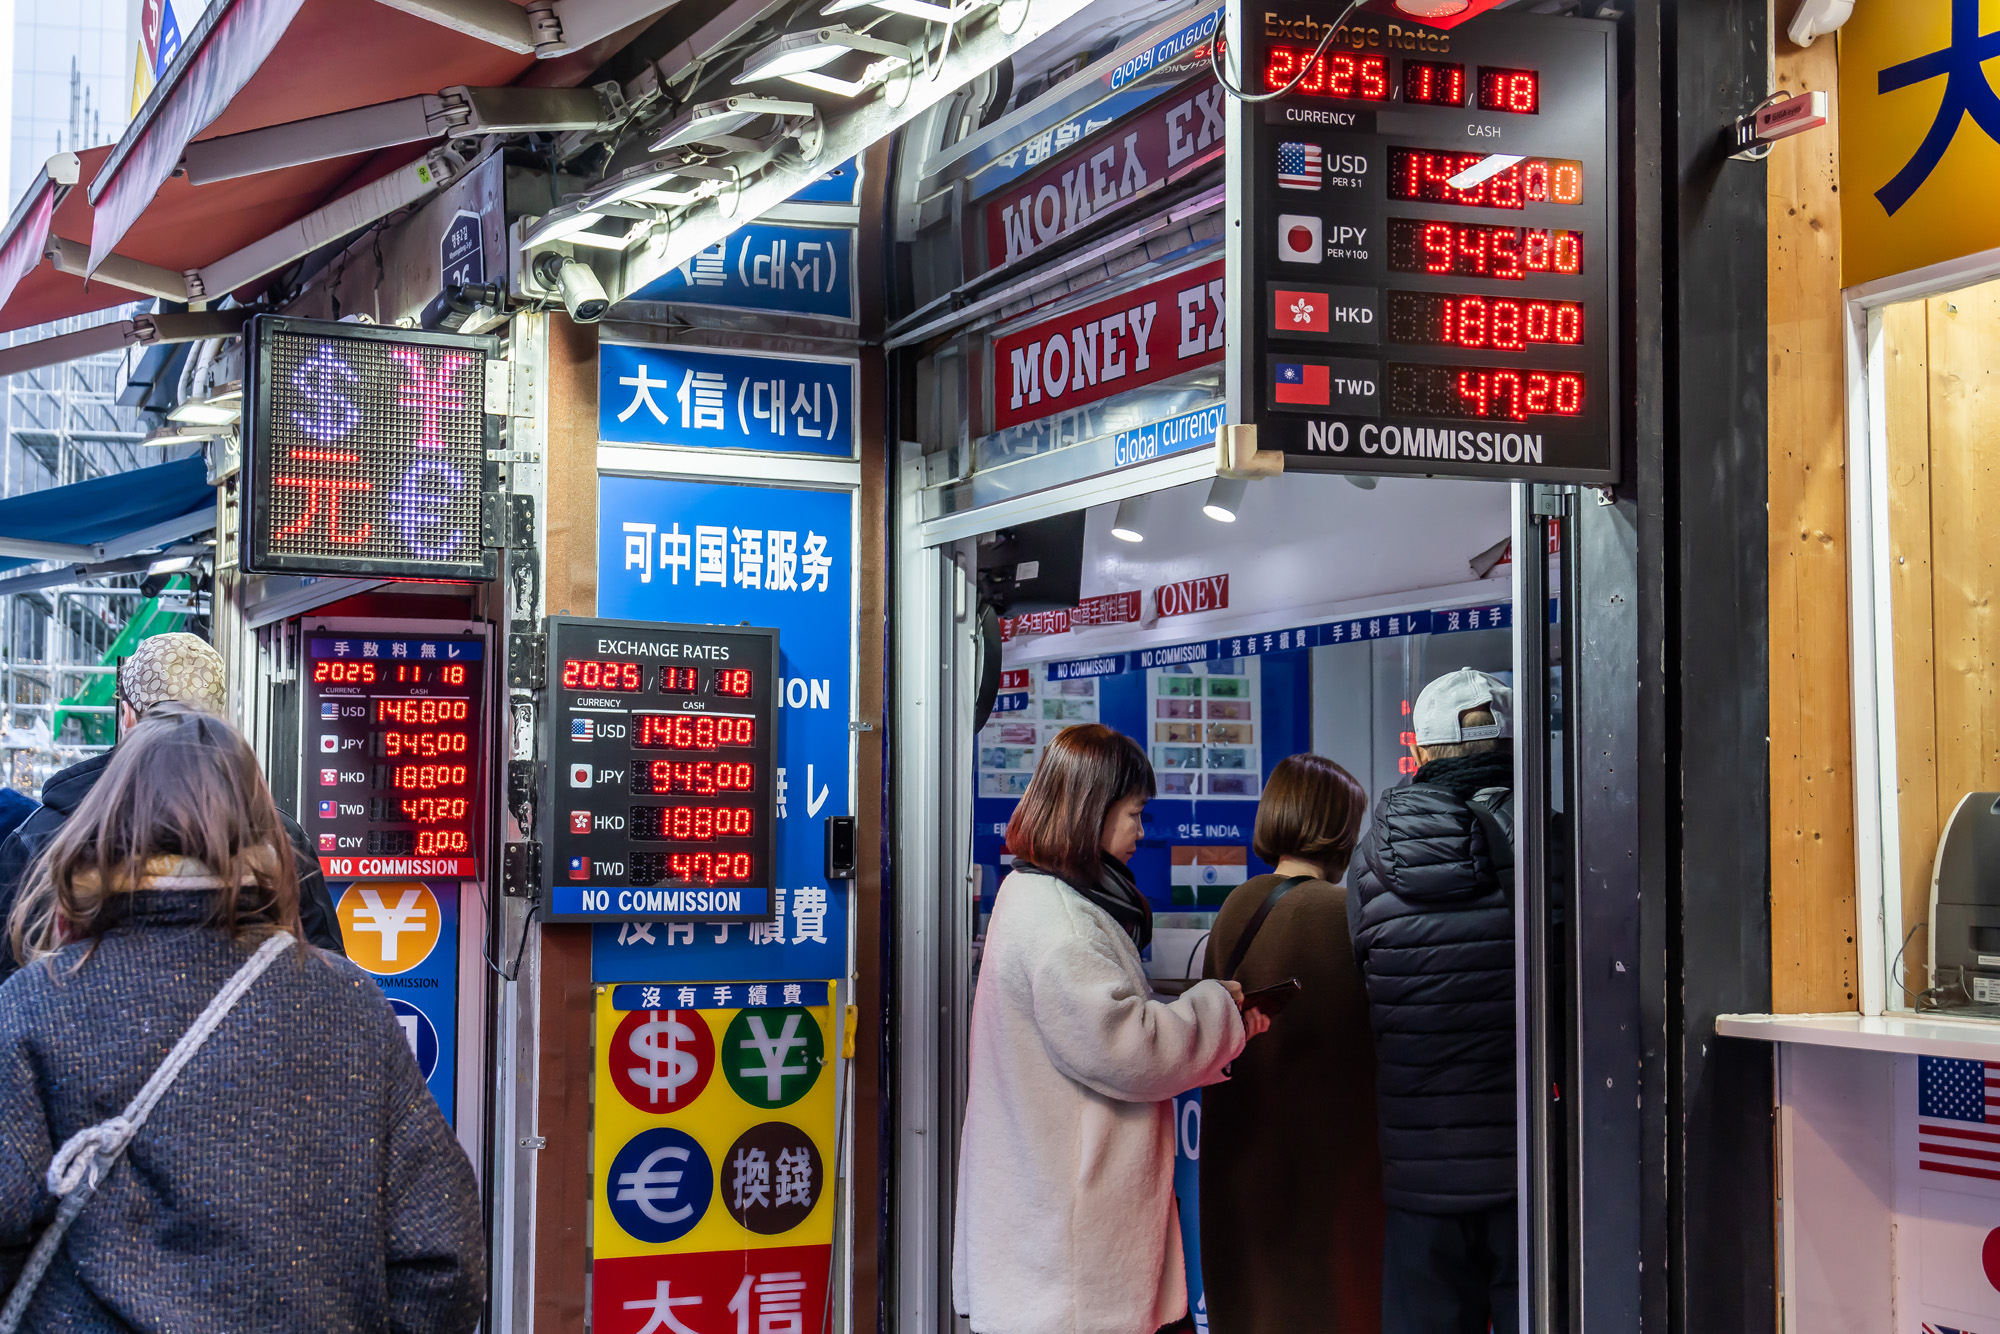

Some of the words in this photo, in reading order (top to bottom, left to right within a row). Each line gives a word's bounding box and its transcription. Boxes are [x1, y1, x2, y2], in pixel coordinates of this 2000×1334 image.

[1388, 24, 1450, 53] Rates
[1269, 51, 1386, 97] 2025
[1418, 68, 1461, 103] 11
[1494, 73, 1533, 111] 18
[1286, 108, 1355, 126] CURRENCY
[1467, 124, 1501, 138] CASH
[1327, 155, 1367, 174] USD
[1332, 177, 1348, 187] PER
[1328, 226, 1367, 245] JPY
[1327, 248, 1344, 258] PER
[1335, 307, 1373, 324] HKD
[1010, 301, 1157, 411] MONEY
[1335, 378, 1376, 396] TWD
[1115, 427, 1158, 465] Global
[1162, 406, 1224, 446] currency
[1307, 420, 1349, 451] NO
[1359, 424, 1543, 464] COMMISSION
[622, 522, 832, 592] 可中国语服务
[1158, 576, 1227, 615] ONEY
[1448, 606, 1512, 631] 沒有手
[598, 640, 679, 657] EXCHANGE
[683, 644, 729, 660] RATES
[1141, 652, 1153, 667] NO
[1155, 643, 1207, 665] COMMISSION
[314, 663, 376, 683] 2025
[399, 666, 421, 682] 11
[442, 665, 465, 684] 18
[1057, 664, 1067, 678] NO
[1070, 658, 1115, 676] COMMISSION
[563, 661, 640, 688] 2025
[668, 667, 694, 690] 11
[722, 670, 748, 694] 18
[577, 697, 621, 708] CURRENCY
[683, 701, 705, 710] CASH
[341, 707, 365, 717] USD
[596, 724, 626, 739] USD
[341, 739, 364, 749] JPY
[340, 772, 365, 783] HKD
[596, 770, 625, 784] JPY
[339, 805, 364, 815] TWD
[594, 816, 625, 829] HKD
[1178, 823, 1203, 838] 인도
[1205, 824, 1240, 838] INDIA
[338, 837, 363, 847] CNY
[330, 859, 352, 874] NO
[358, 859, 458, 875] COMMISSION
[594, 862, 624, 875] TWD
[582, 890, 610, 911] NO
[618, 890, 741, 911] COMMISSION
[373, 977, 439, 988] OMMISSION
[733, 1147, 813, 1209] 換錢
